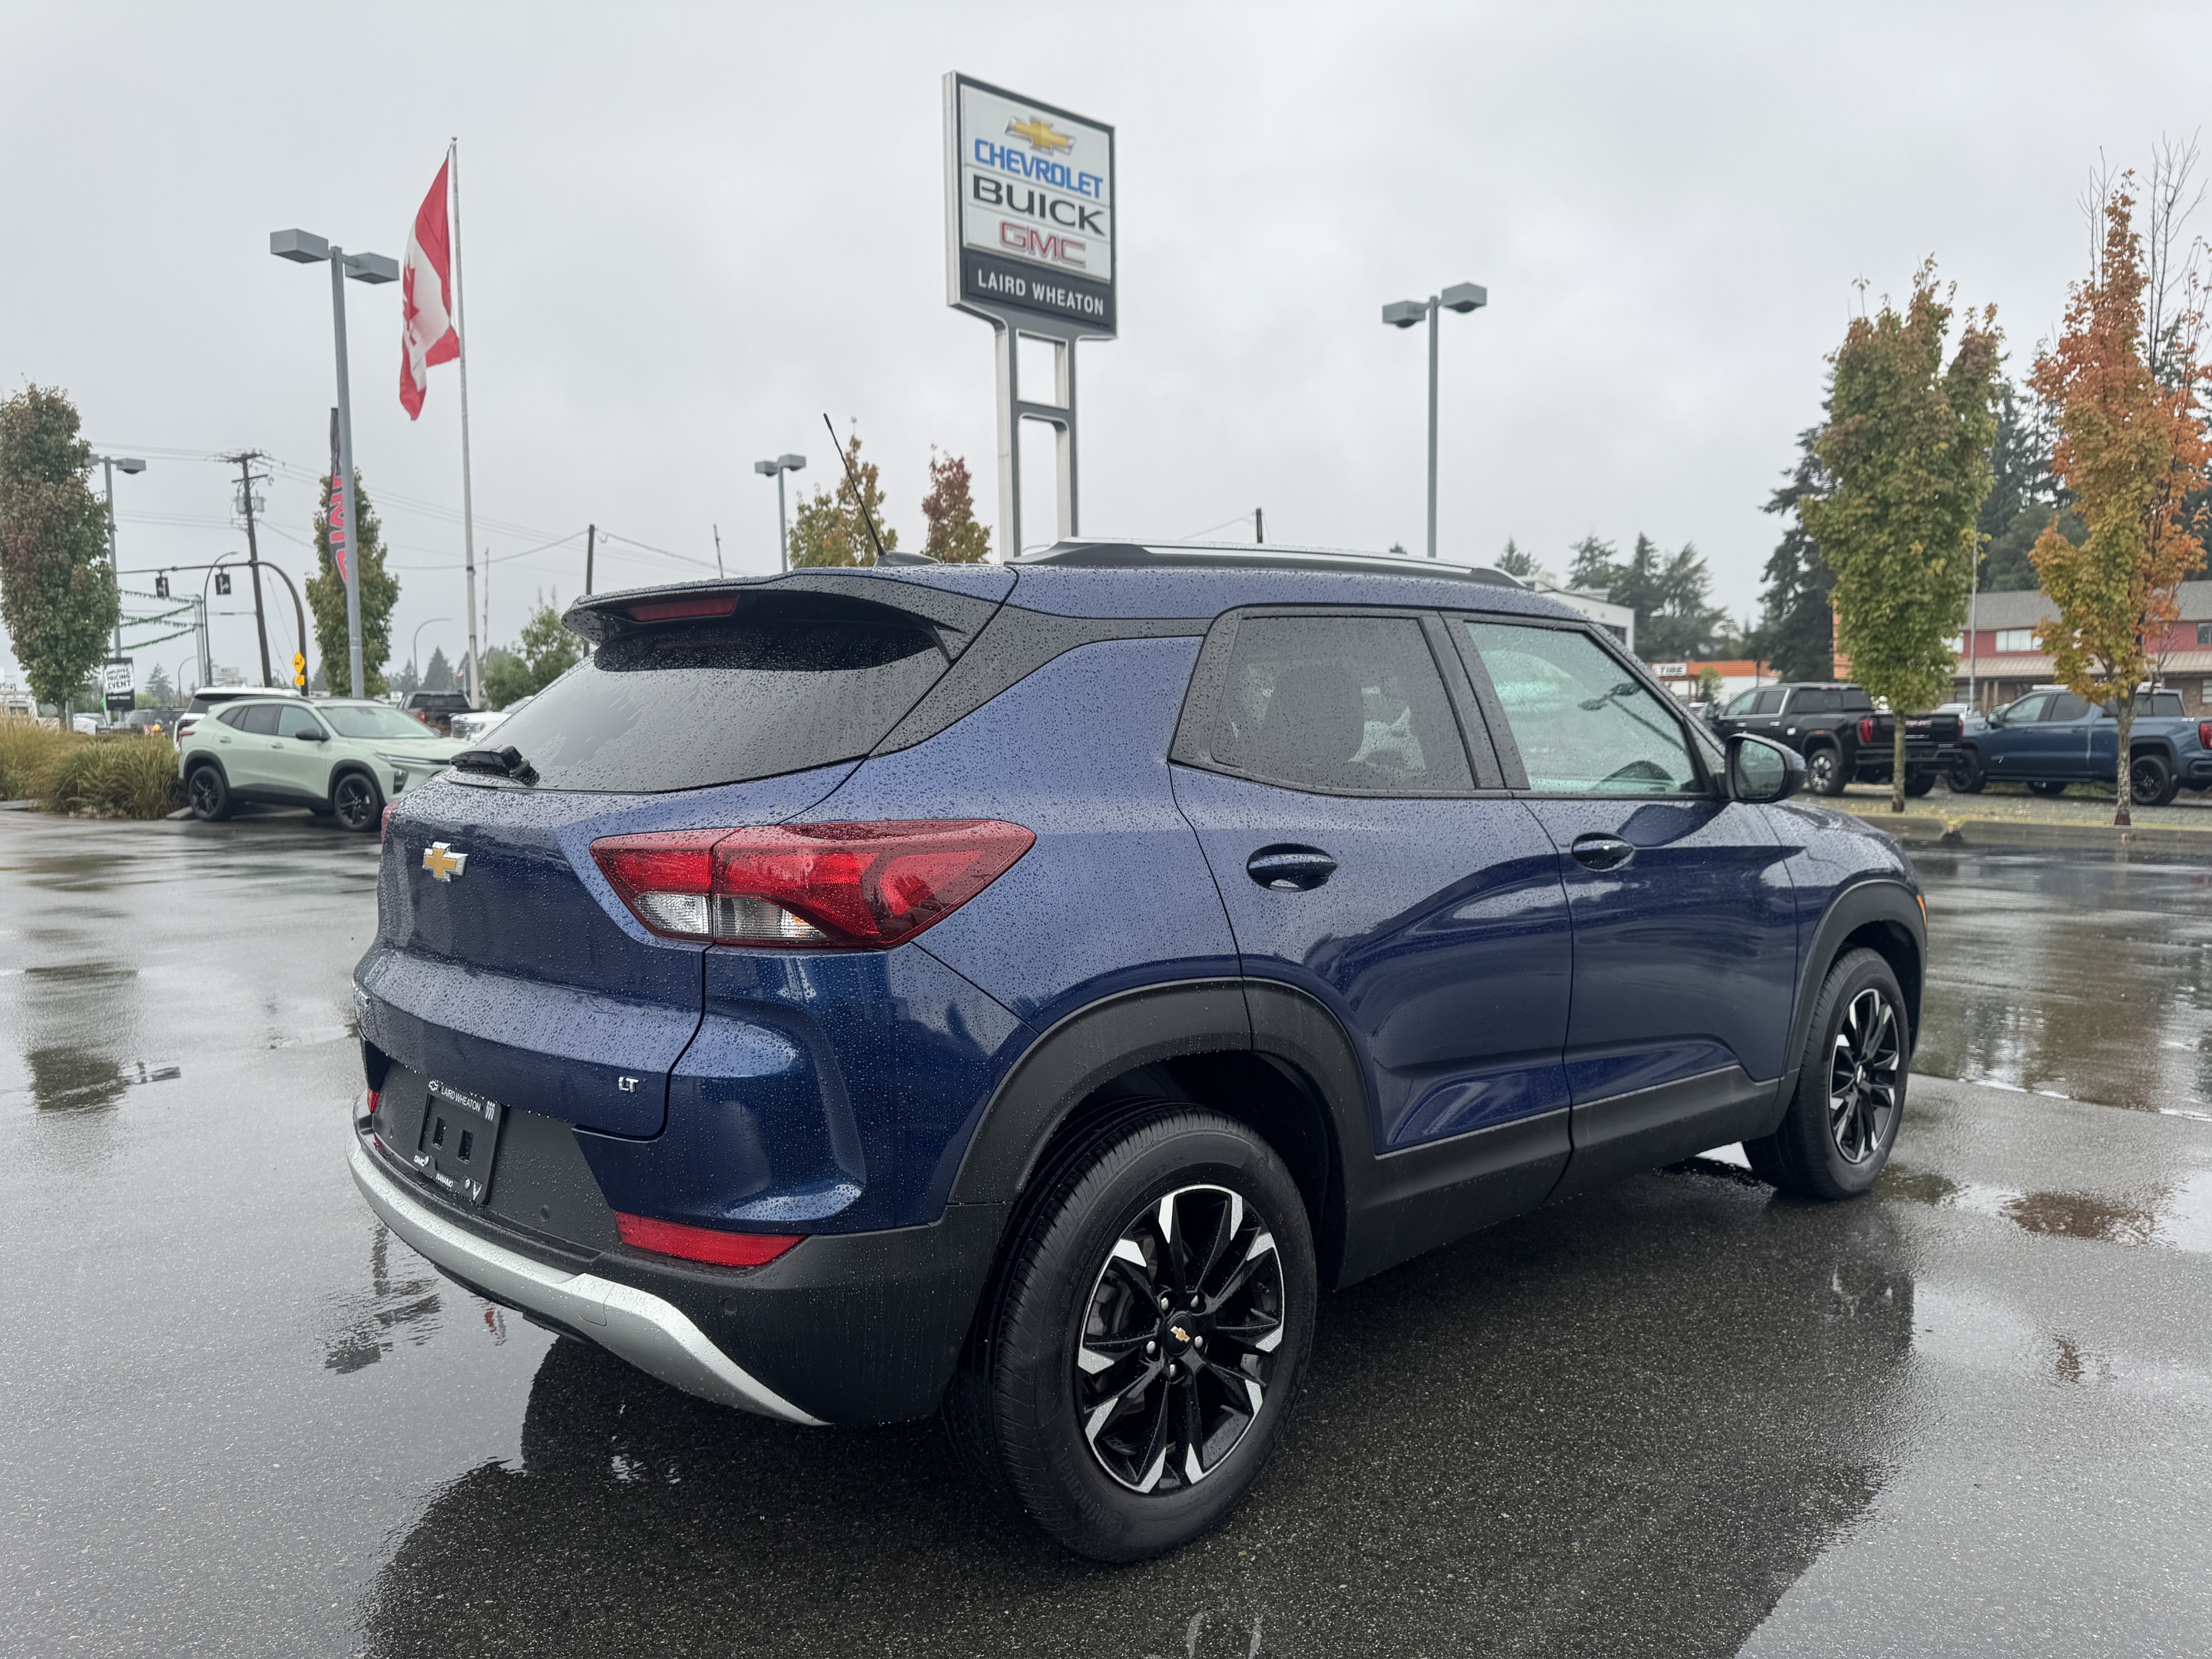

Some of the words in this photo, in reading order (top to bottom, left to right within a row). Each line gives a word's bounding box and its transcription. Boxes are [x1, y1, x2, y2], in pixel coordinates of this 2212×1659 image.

[975, 138, 1104, 199] CHEVROLET
[973, 174, 1105, 237] BUICK
[1000, 220, 1087, 269] GMC
[978, 269, 1026, 296] LAIRD
[1032, 282, 1104, 316] WHEATON
[108, 680, 131, 690] EVENT
[618, 1076, 639, 1093] LT
[441, 1086, 455, 1100] LAIRD
[455, 1092, 482, 1112] WHEATON
[414, 1155, 426, 1167] GMC
[435, 1173, 453, 1188] NANAIMO
